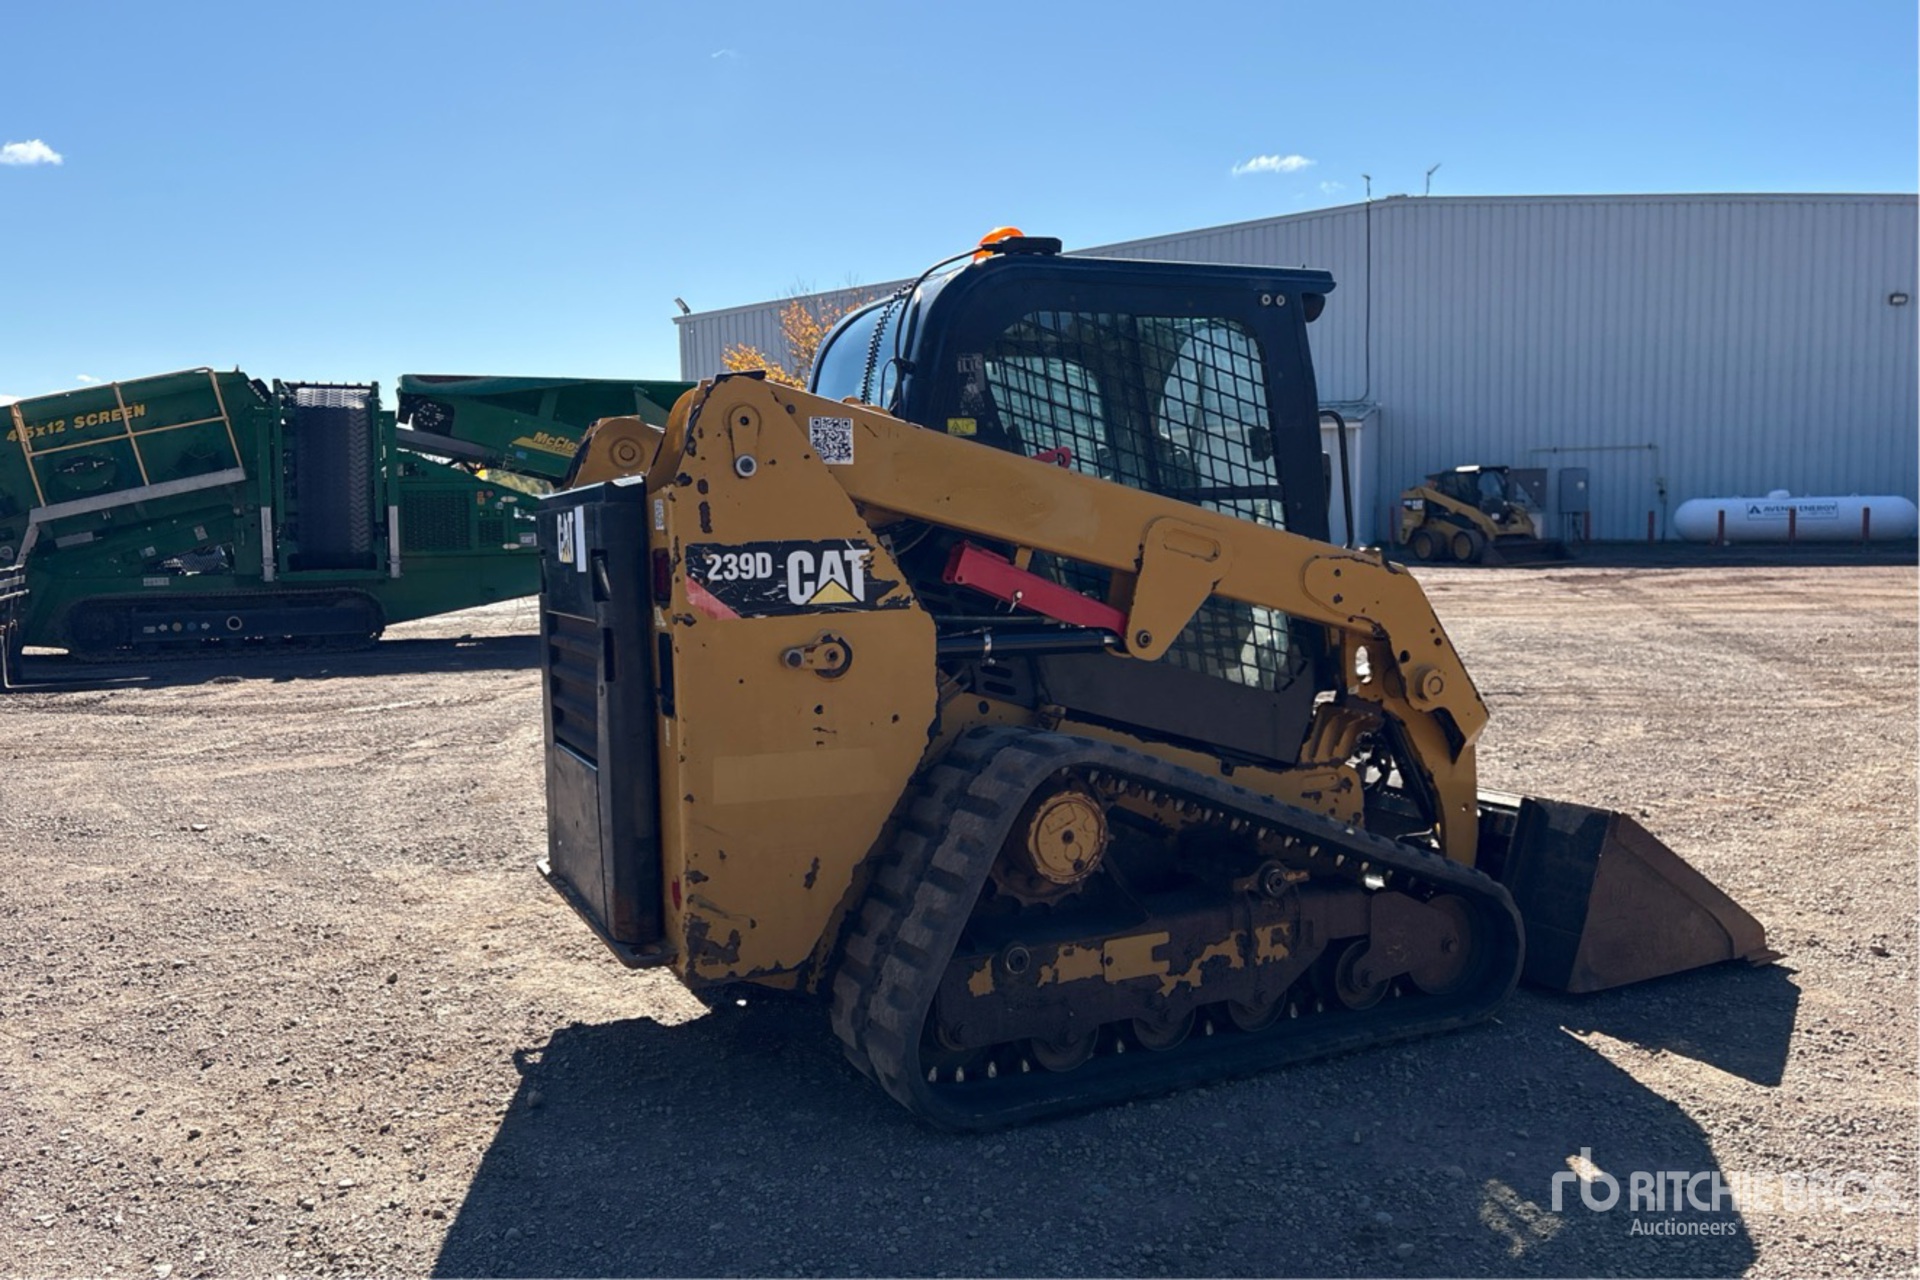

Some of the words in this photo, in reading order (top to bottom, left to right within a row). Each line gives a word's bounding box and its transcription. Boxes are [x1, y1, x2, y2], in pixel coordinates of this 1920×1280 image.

[73, 404, 146, 429] SCREEN
[557, 511, 574, 563] CAT
[706, 552, 773, 581] 239D
[787, 549, 870, 606] CAT
